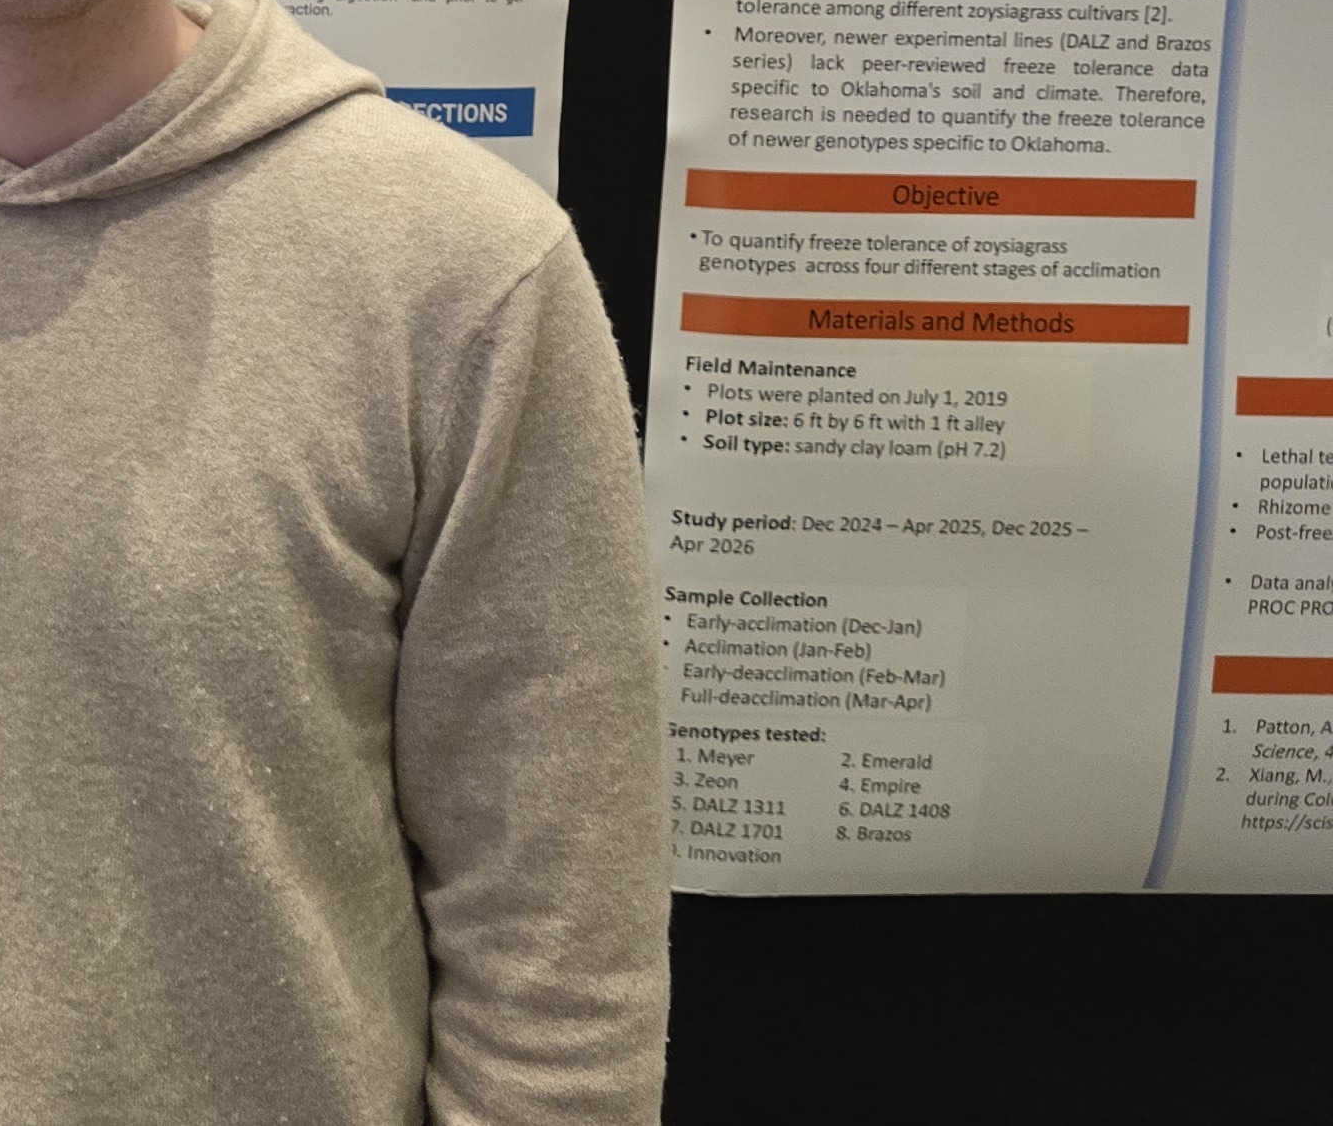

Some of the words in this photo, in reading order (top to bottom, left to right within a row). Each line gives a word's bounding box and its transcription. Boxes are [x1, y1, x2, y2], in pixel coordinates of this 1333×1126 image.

[734, 26, 827, 47] Moreover,
[832, 31, 889, 46] newer
[893, 30, 1008, 50] experimental
[1013, 30, 1054, 49] lines
[1059, 31, 1111, 52] (DALZ
[1115, 34, 1150, 51] and
[1155, 34, 1212, 53] Brazos
[892, 183, 1000, 211] Objective
[808, 309, 916, 332] Materials
[921, 309, 965, 332] and
[972, 311, 1075, 335] Methods
[685, 355, 732, 375] Field
[737, 359, 857, 379] Maintenance
[707, 382, 754, 402] Plots
[757, 389, 804, 404] were
[806, 387, 875, 407] planted
[877, 391, 901, 406] on
[904, 388, 940, 409] July
[942, 389, 959, 409] 1,
[963, 389, 1008, 408] 2019
[663, 585, 735, 609] Sample
[739, 590, 828, 609] Collection
[840, 751, 856, 769] 2.
[861, 752, 934, 771] Emerald
[837, 800, 854, 817] 6.
[858, 801, 905, 820] DALZ
[907, 803, 952, 820] 1408
